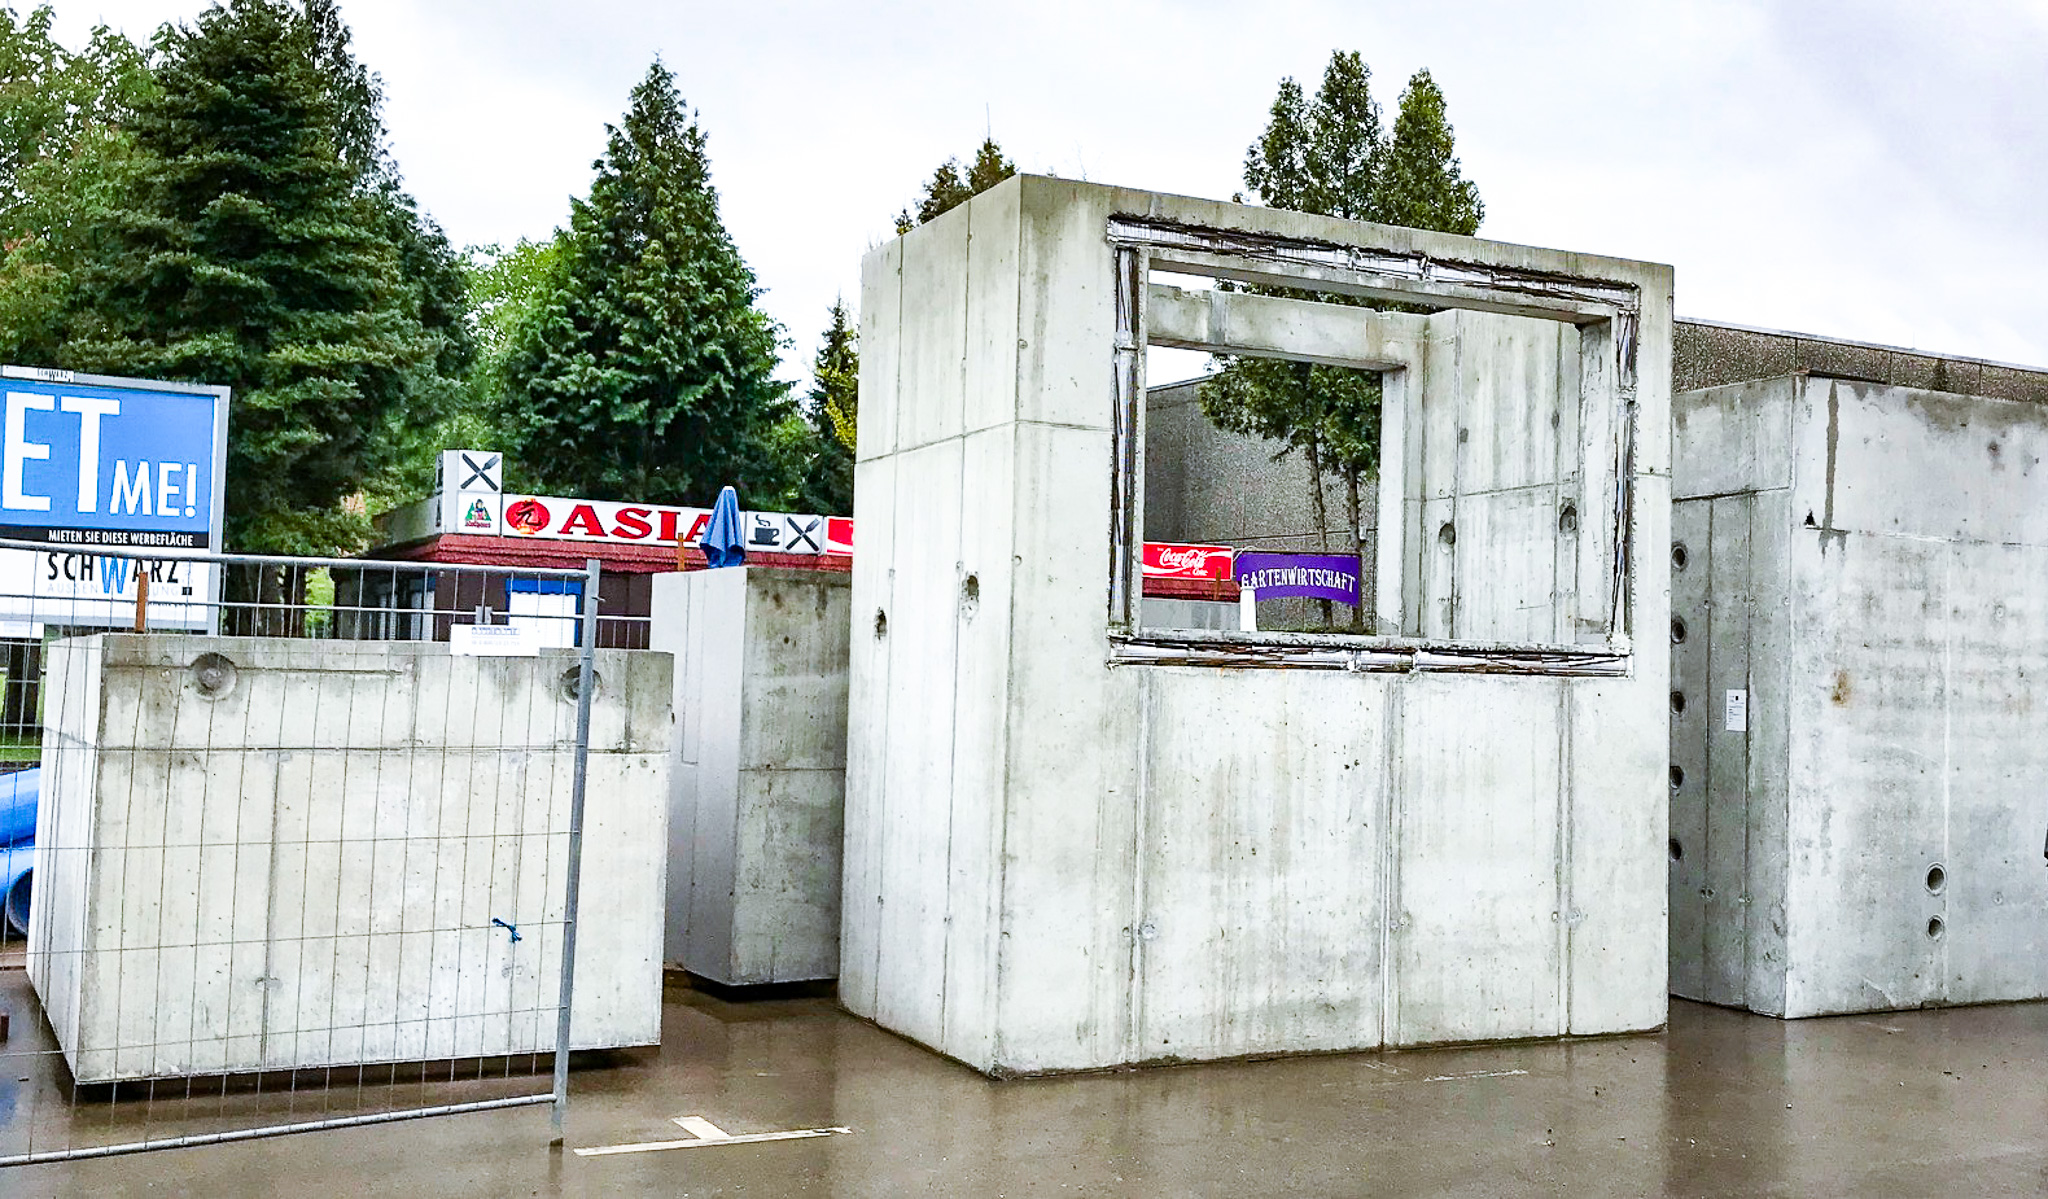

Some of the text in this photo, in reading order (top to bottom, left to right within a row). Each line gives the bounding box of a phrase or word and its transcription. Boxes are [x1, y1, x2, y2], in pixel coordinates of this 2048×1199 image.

[2, 391, 197, 518] ET ME!
[48, 529, 193, 547] MIETEN SIE DIESE WERBEFLÄCHE
[557, 504, 712, 542] ASIA
[47, 553, 179, 594] SCHWARZ
[1241, 565, 1356, 593] GARTENWIRTSCHAFT
